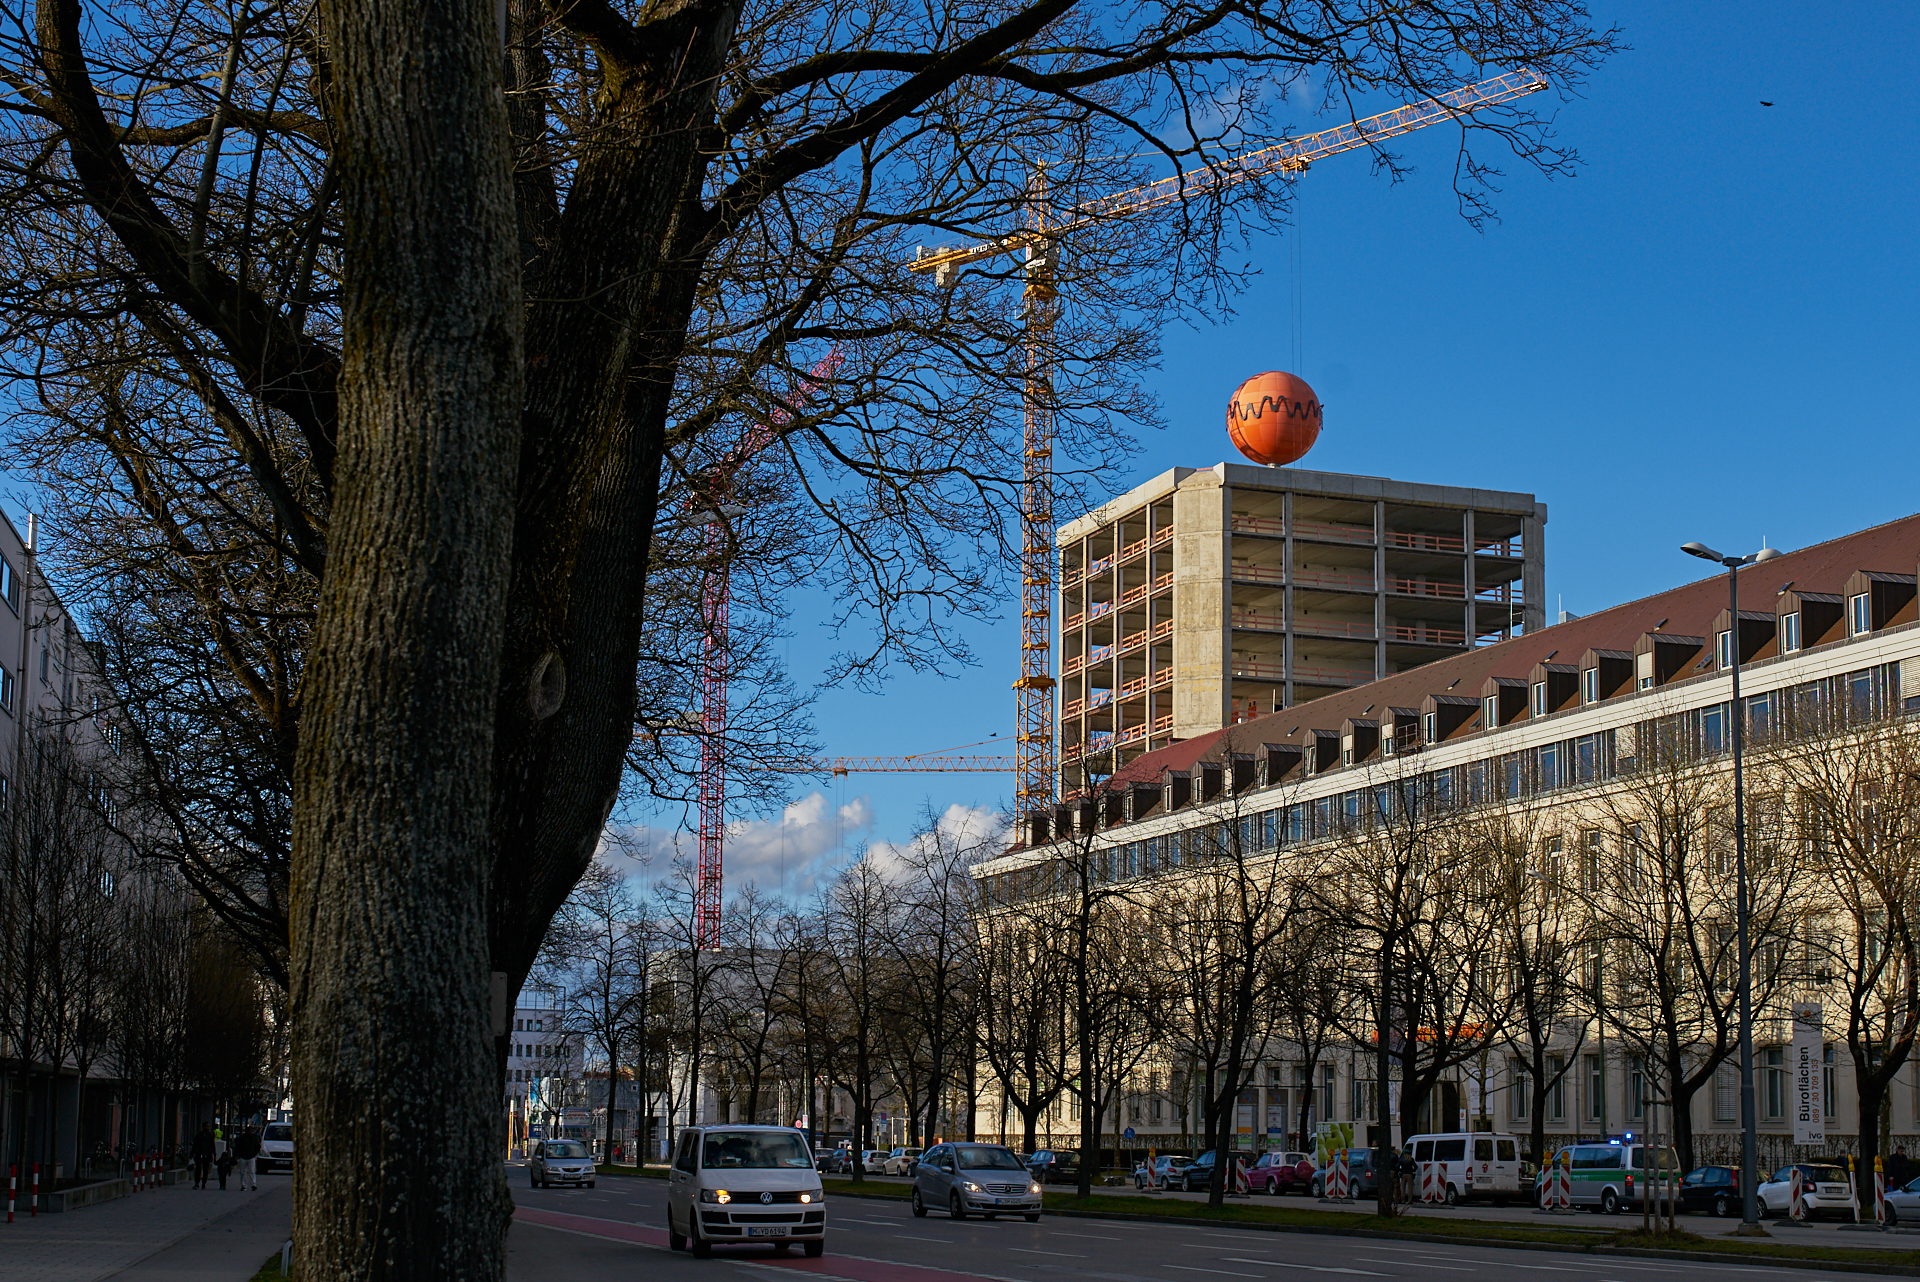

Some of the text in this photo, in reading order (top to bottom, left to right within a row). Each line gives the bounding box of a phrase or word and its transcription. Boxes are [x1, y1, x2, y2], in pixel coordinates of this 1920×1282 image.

[1798, 1047, 1810, 1122] Büroflächen
[1811, 1075, 1819, 1090] 709
[1811, 1092, 1819, 1102] 30
[1317, 1124, 1331, 1133] REWE
